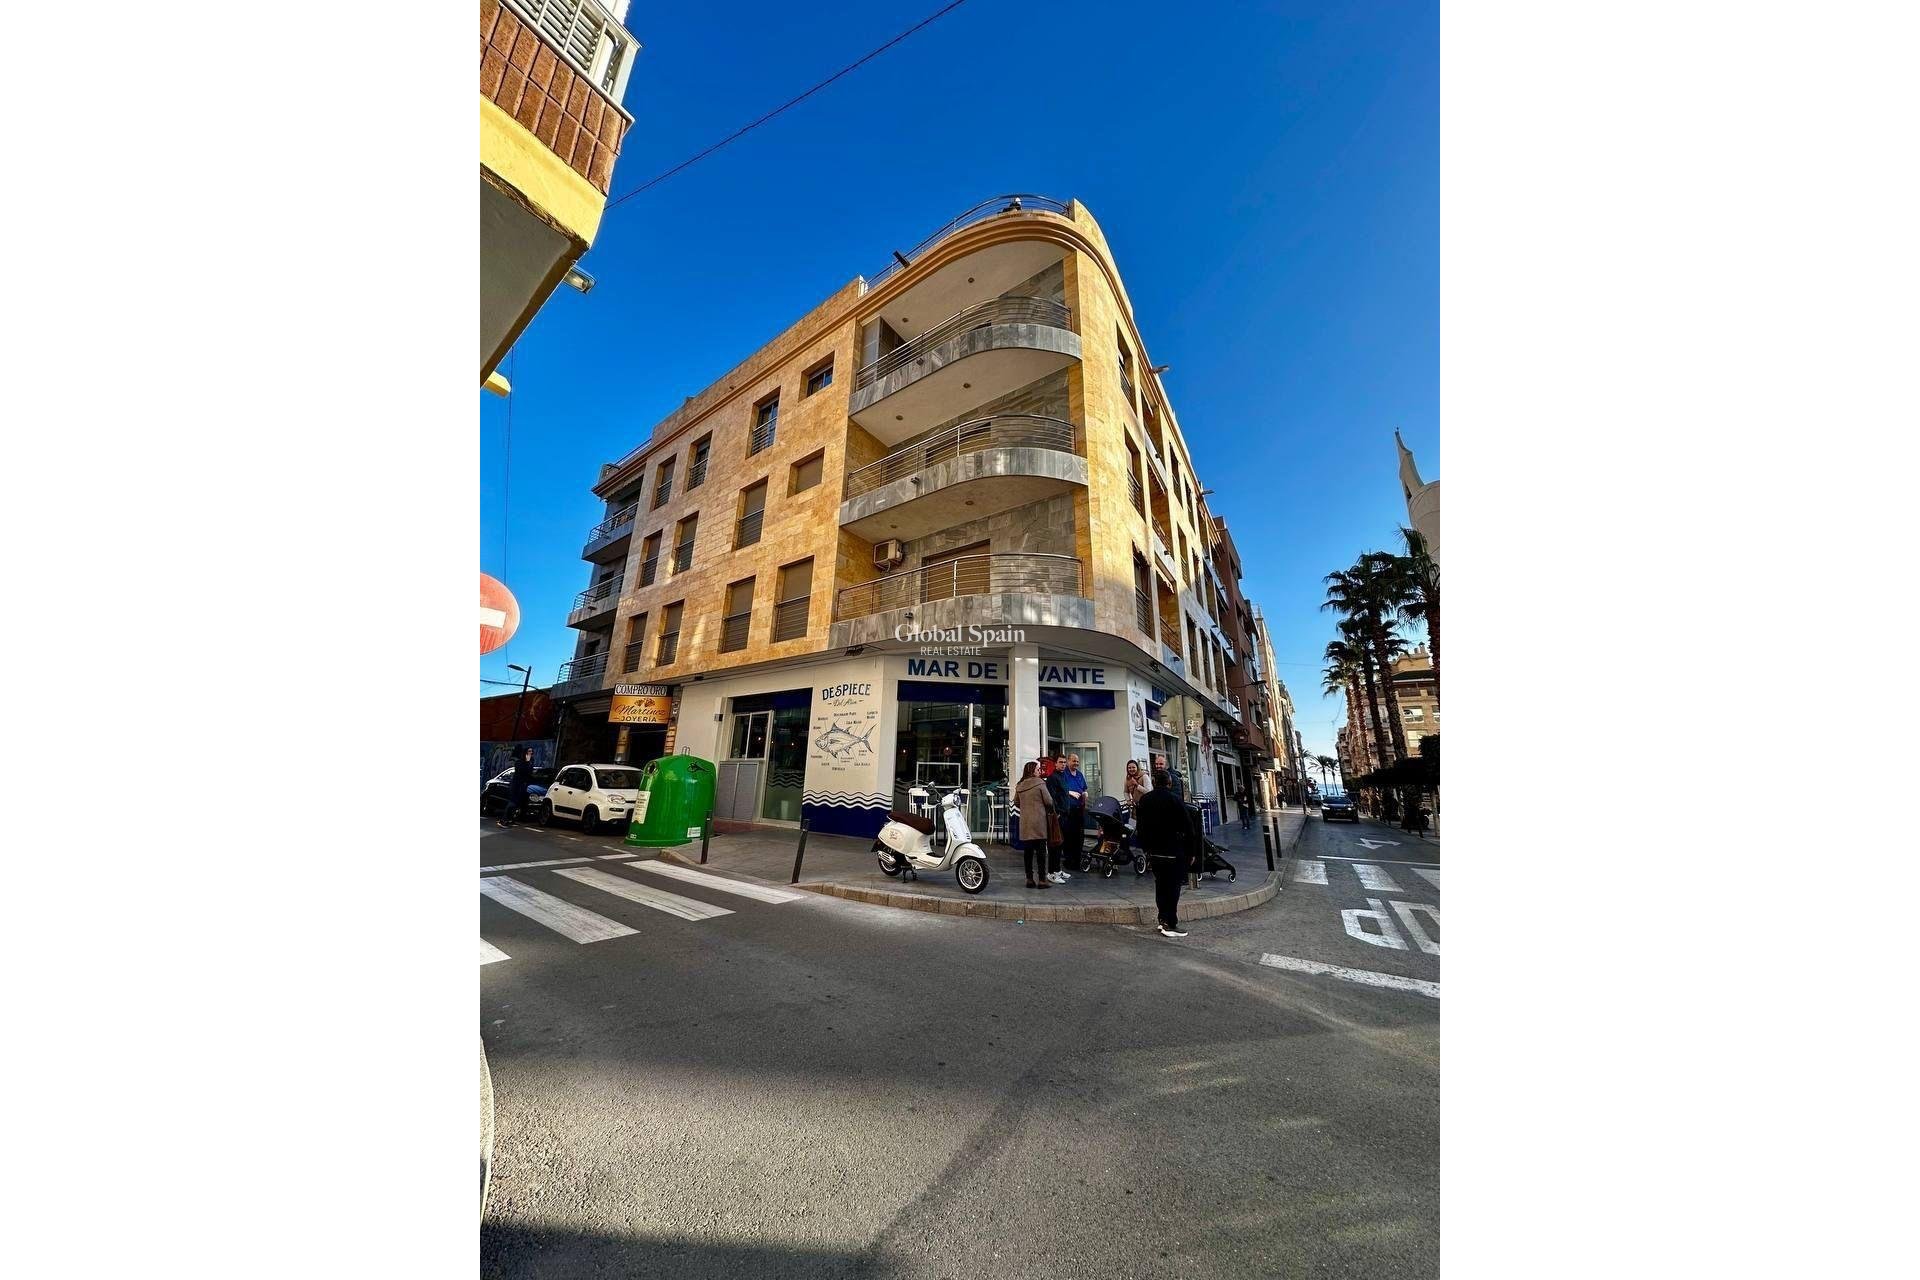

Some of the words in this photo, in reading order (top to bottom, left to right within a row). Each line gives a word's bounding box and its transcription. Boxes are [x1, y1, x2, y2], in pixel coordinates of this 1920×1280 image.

[907, 658, 960, 678] MAR
[968, 661, 998, 679] DE
[1006, 664, 1105, 685] VANTE
[615, 684, 649, 695] COMPRO
[650, 685, 667, 696] ORO
[822, 683, 872, 701] DESPIECE
